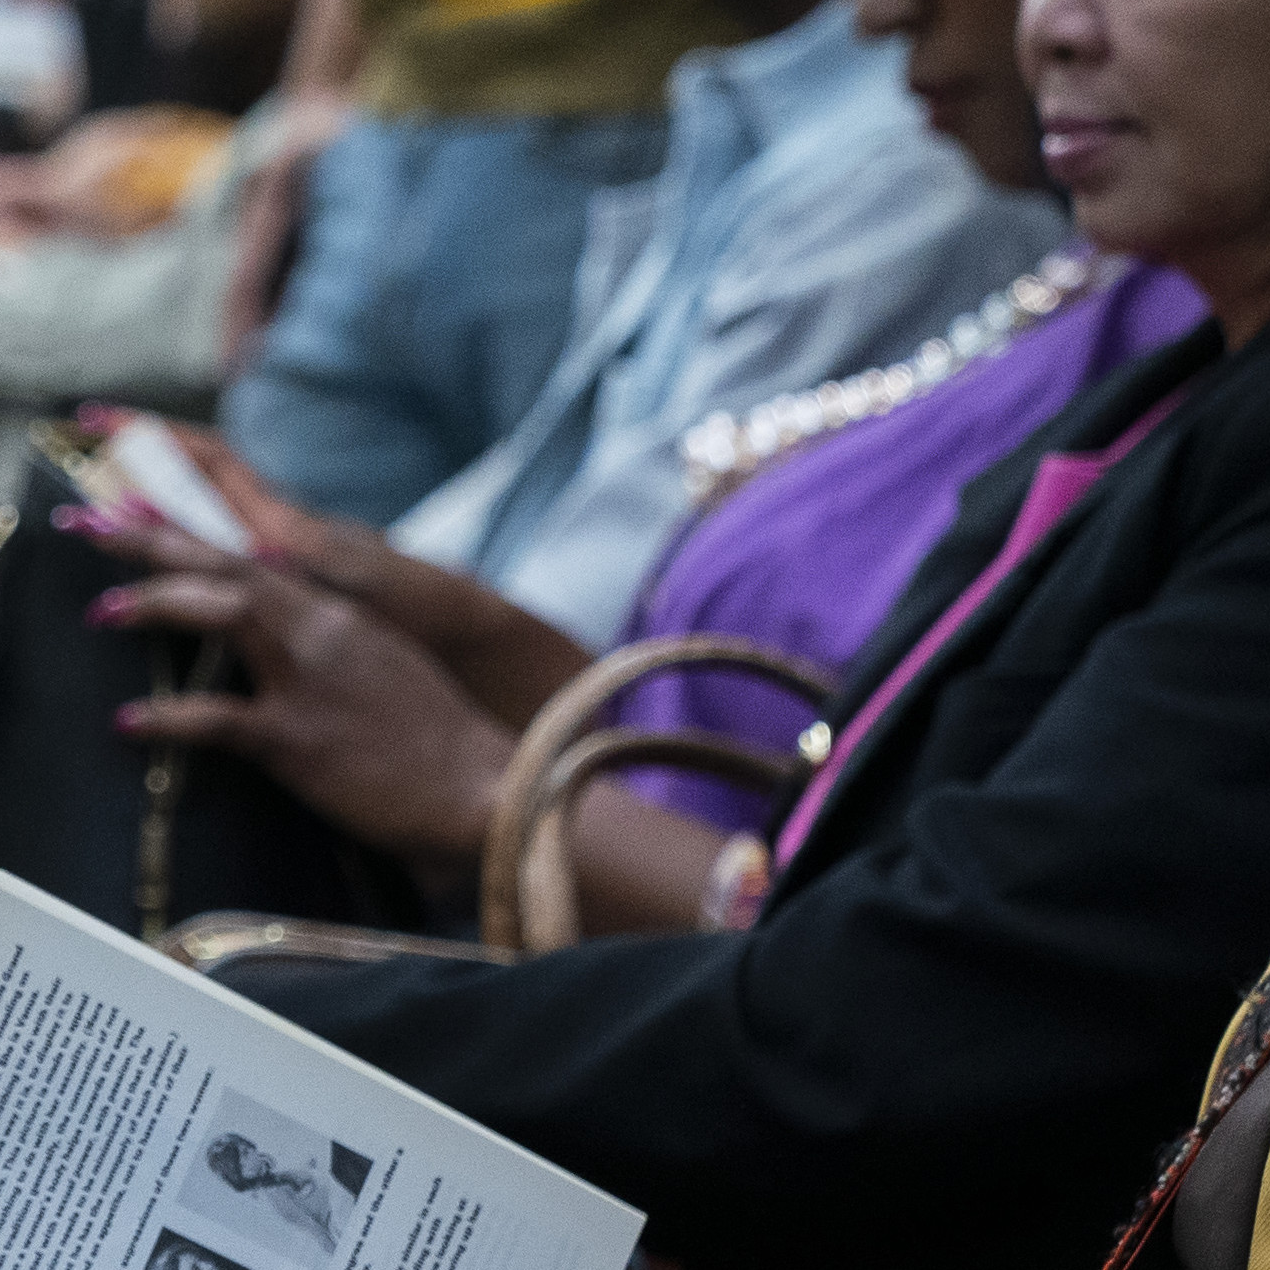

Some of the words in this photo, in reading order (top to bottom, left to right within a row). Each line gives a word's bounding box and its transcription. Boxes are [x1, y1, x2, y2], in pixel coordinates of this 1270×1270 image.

[0, 943, 24, 982] Grand
[30, 1008, 48, 1037] with
[43, 976, 62, 1006] their
[1, 1145, 22, 1171] This
[16, 1099, 42, 1145] picture
[44, 1050, 64, 1085] made
[67, 993, 90, 1033] appeal
[2, 1112, 19, 1137] way
[35, 1020, 62, 1065] display
[2, 1198, 33, 1251] tradition
[55, 1114, 71, 1135] the
[66, 1046, 102, 1113] convention
[104, 1005, 120, 1029] not
[21, 1194, 52, 1250] woman's
[45, 1162, 68, 1194] body
[60, 1127, 83, 1162] helps
[77, 1075, 106, 1125] towards
[101, 1052, 116, 1073] the
[112, 1018, 131, 1050] same
[32, 1120, 50, 1149] with
[43, 1097, 61, 1119] her
[121, 1163, 137, 1186] not
[137, 1116, 158, 1147] have
[153, 1093, 169, 1115] any
[170, 1045, 188, 1075] their
[39, 1220, 58, 1249] with
[54, 1178, 76, 1219] sexual
[92, 1104, 110, 1133] with
[128, 1026, 146, 1048] The
[58, 1210, 80, 1247] needs
[126, 1067, 144, 1094] that
[139, 1045, 154, 1066] the
[76, 1219, 94, 1243] has
[88, 1196, 104, 1218] the
[99, 1136, 132, 1196] monopoly
[134, 1088, 152, 1118] such
[119, 1196, 158, 1268] expressions
[159, 1143, 181, 1178] these
[174, 1117, 192, 1142] two
[360, 1213, 375, 1238] and
[369, 1191, 385, 1213] the
[380, 1157, 399, 1191] other
[400, 1220, 423, 1263] similar
[425, 1176, 442, 1205] each
[424, 1216, 442, 1246] with
[434, 1213, 462, 1260] looking
[465, 1202, 482, 1225] her
